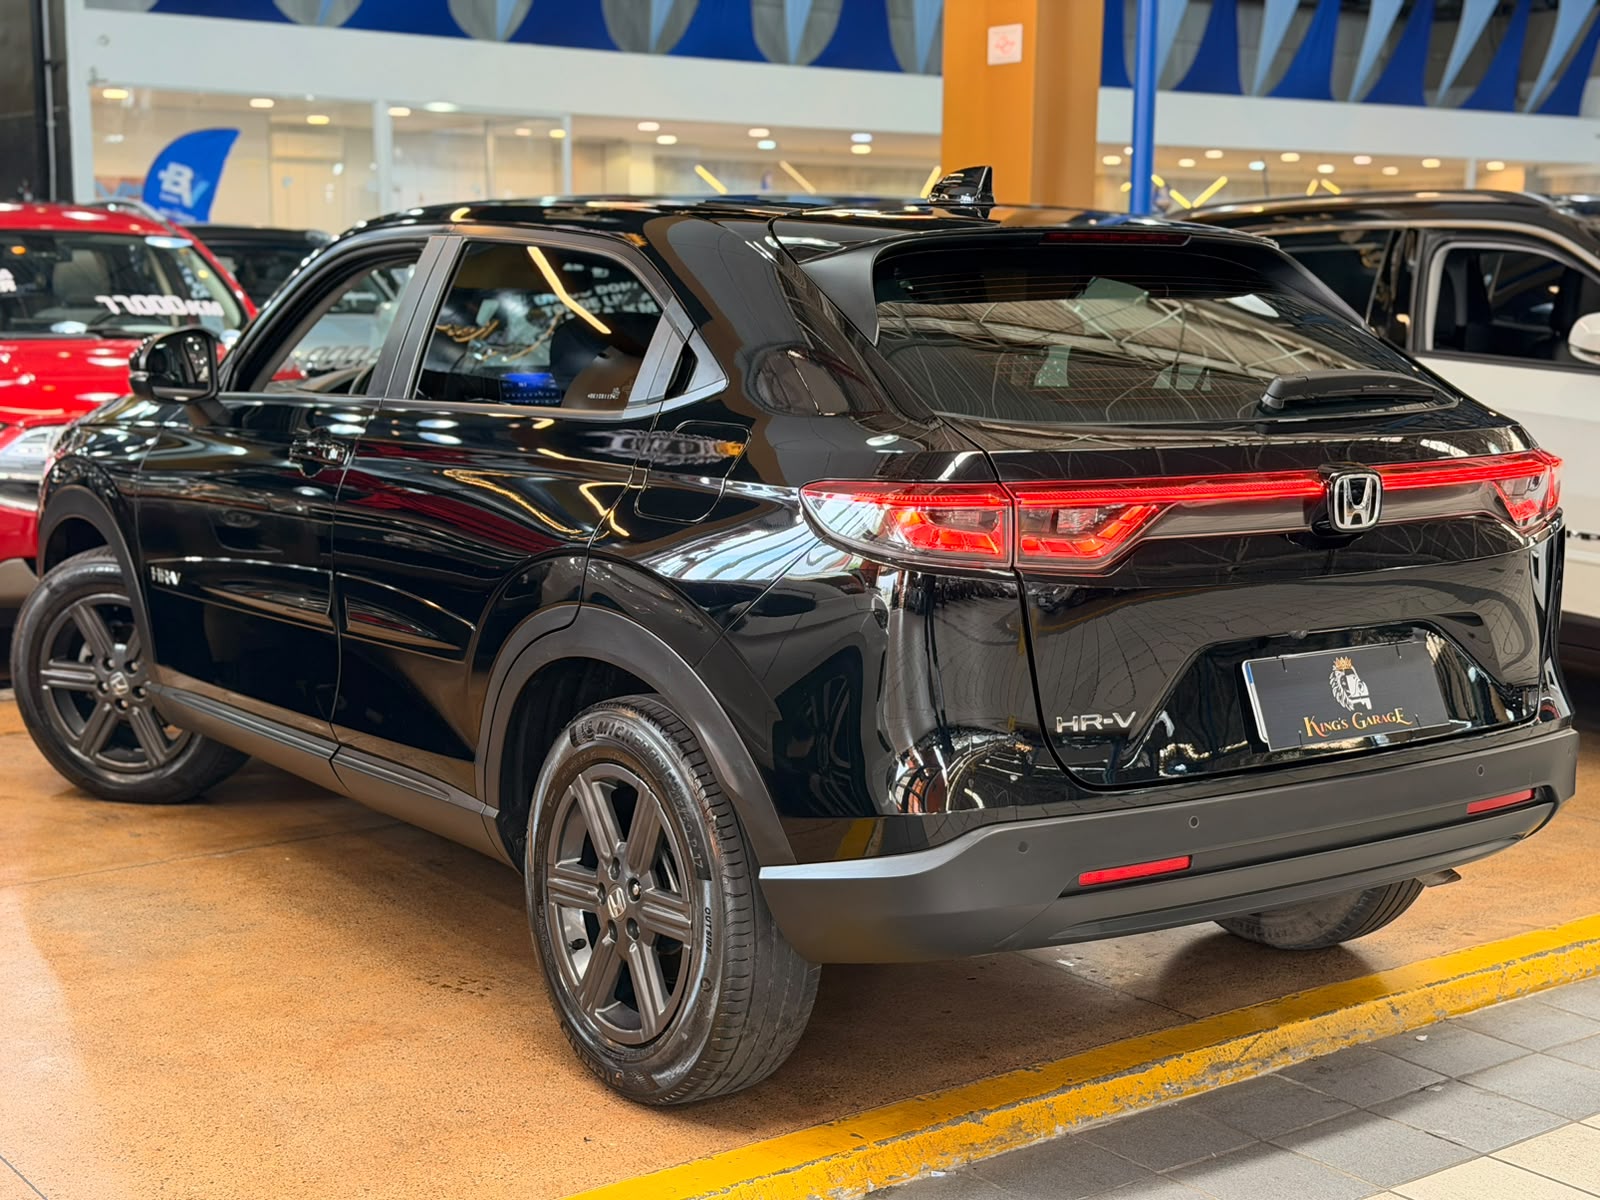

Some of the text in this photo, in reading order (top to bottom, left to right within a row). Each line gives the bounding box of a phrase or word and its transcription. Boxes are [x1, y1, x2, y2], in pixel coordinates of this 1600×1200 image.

[1056, 711, 1136, 733] HR-V
[1304, 707, 1413, 738] KING'S GARAGE
[704, 907, 713, 956] OUTSIDE
